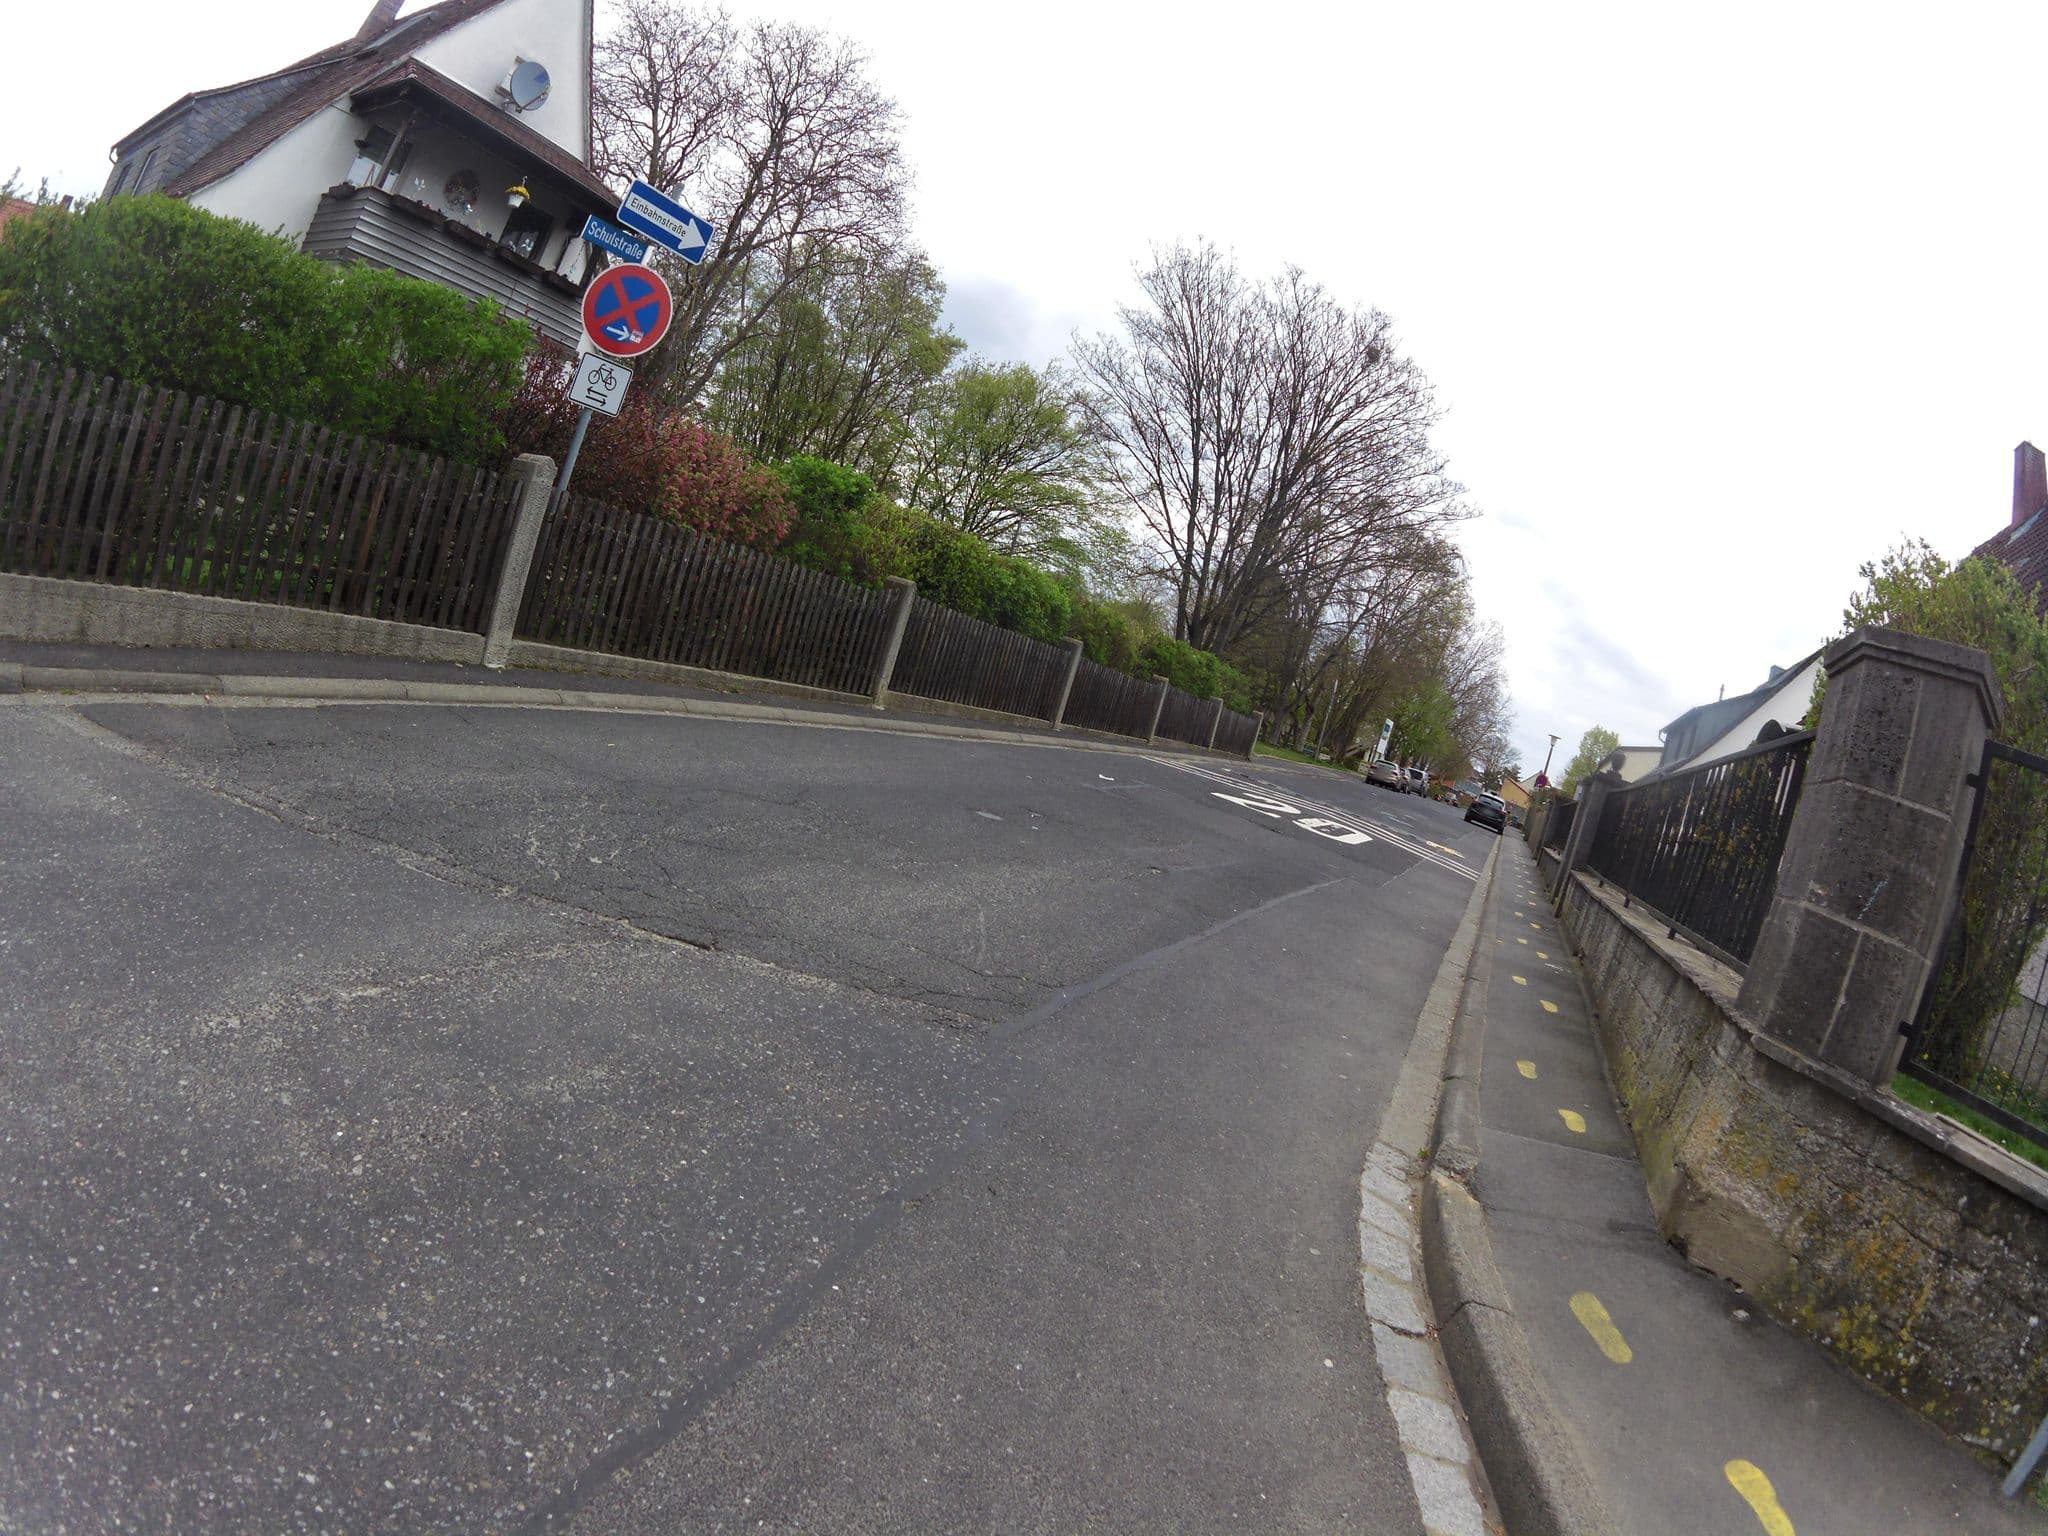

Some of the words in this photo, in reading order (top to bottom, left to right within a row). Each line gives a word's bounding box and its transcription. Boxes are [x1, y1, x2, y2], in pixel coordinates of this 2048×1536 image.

[630, 197, 687, 237] Einbahnstraße
[588, 220, 643, 260] Schulstraße
[1210, 792, 1374, 845] 20
